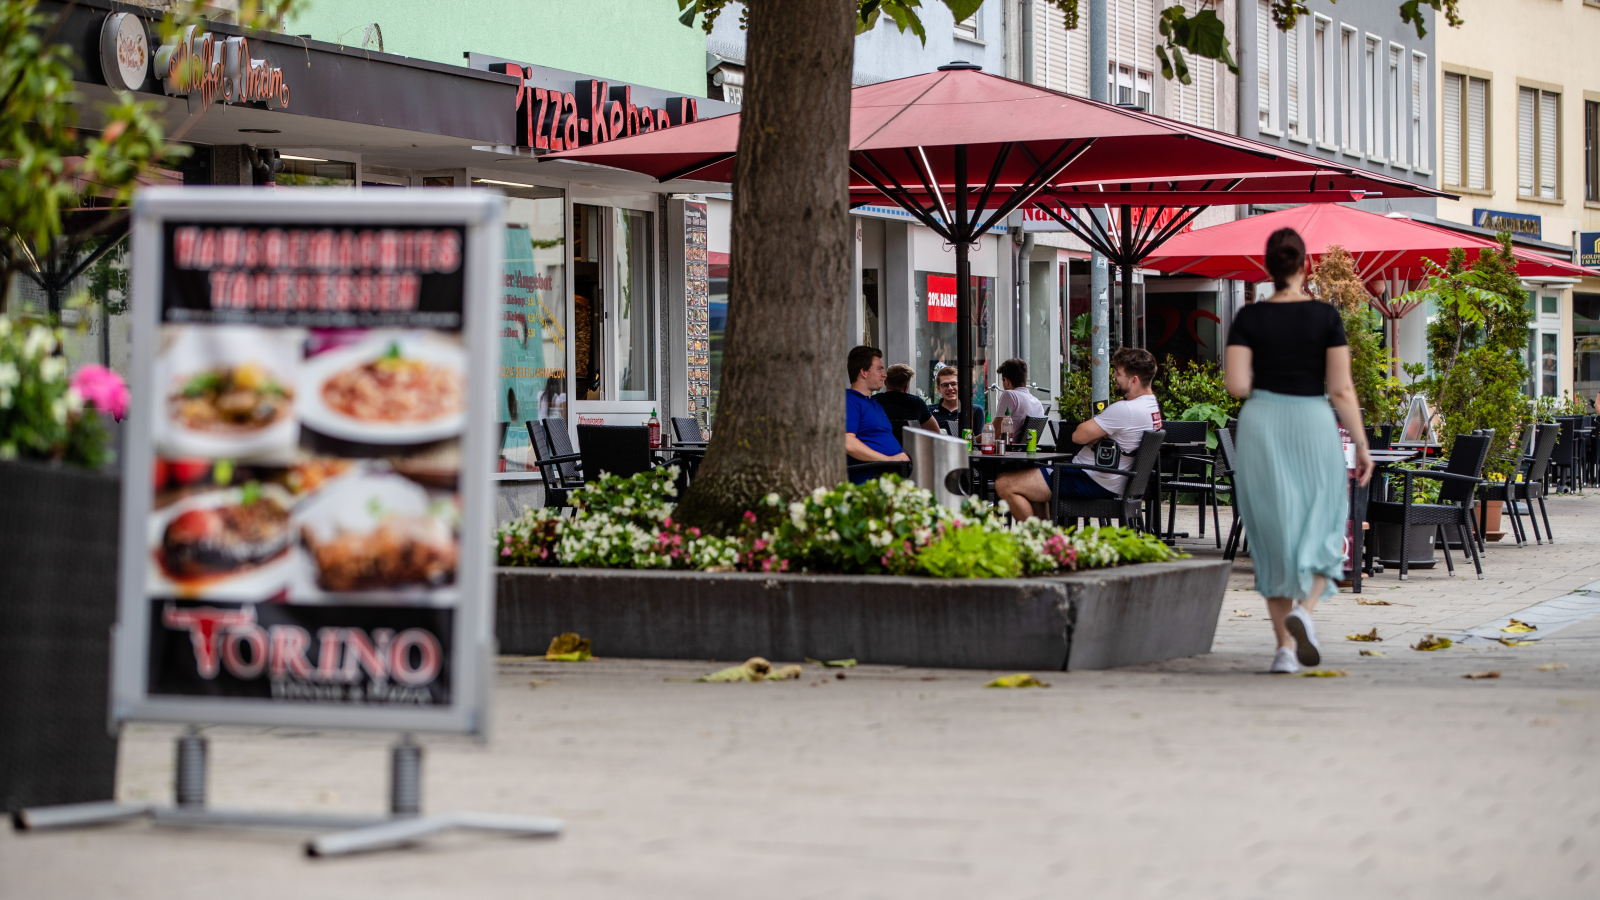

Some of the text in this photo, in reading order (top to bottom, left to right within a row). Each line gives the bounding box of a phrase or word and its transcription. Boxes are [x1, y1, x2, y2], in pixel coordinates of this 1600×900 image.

[169, 25, 290, 113] Waffel Dream
[928, 291, 957, 308] 20% RABAT
[507, 327, 518, 338] Box
[162, 602, 443, 688] TORINO
